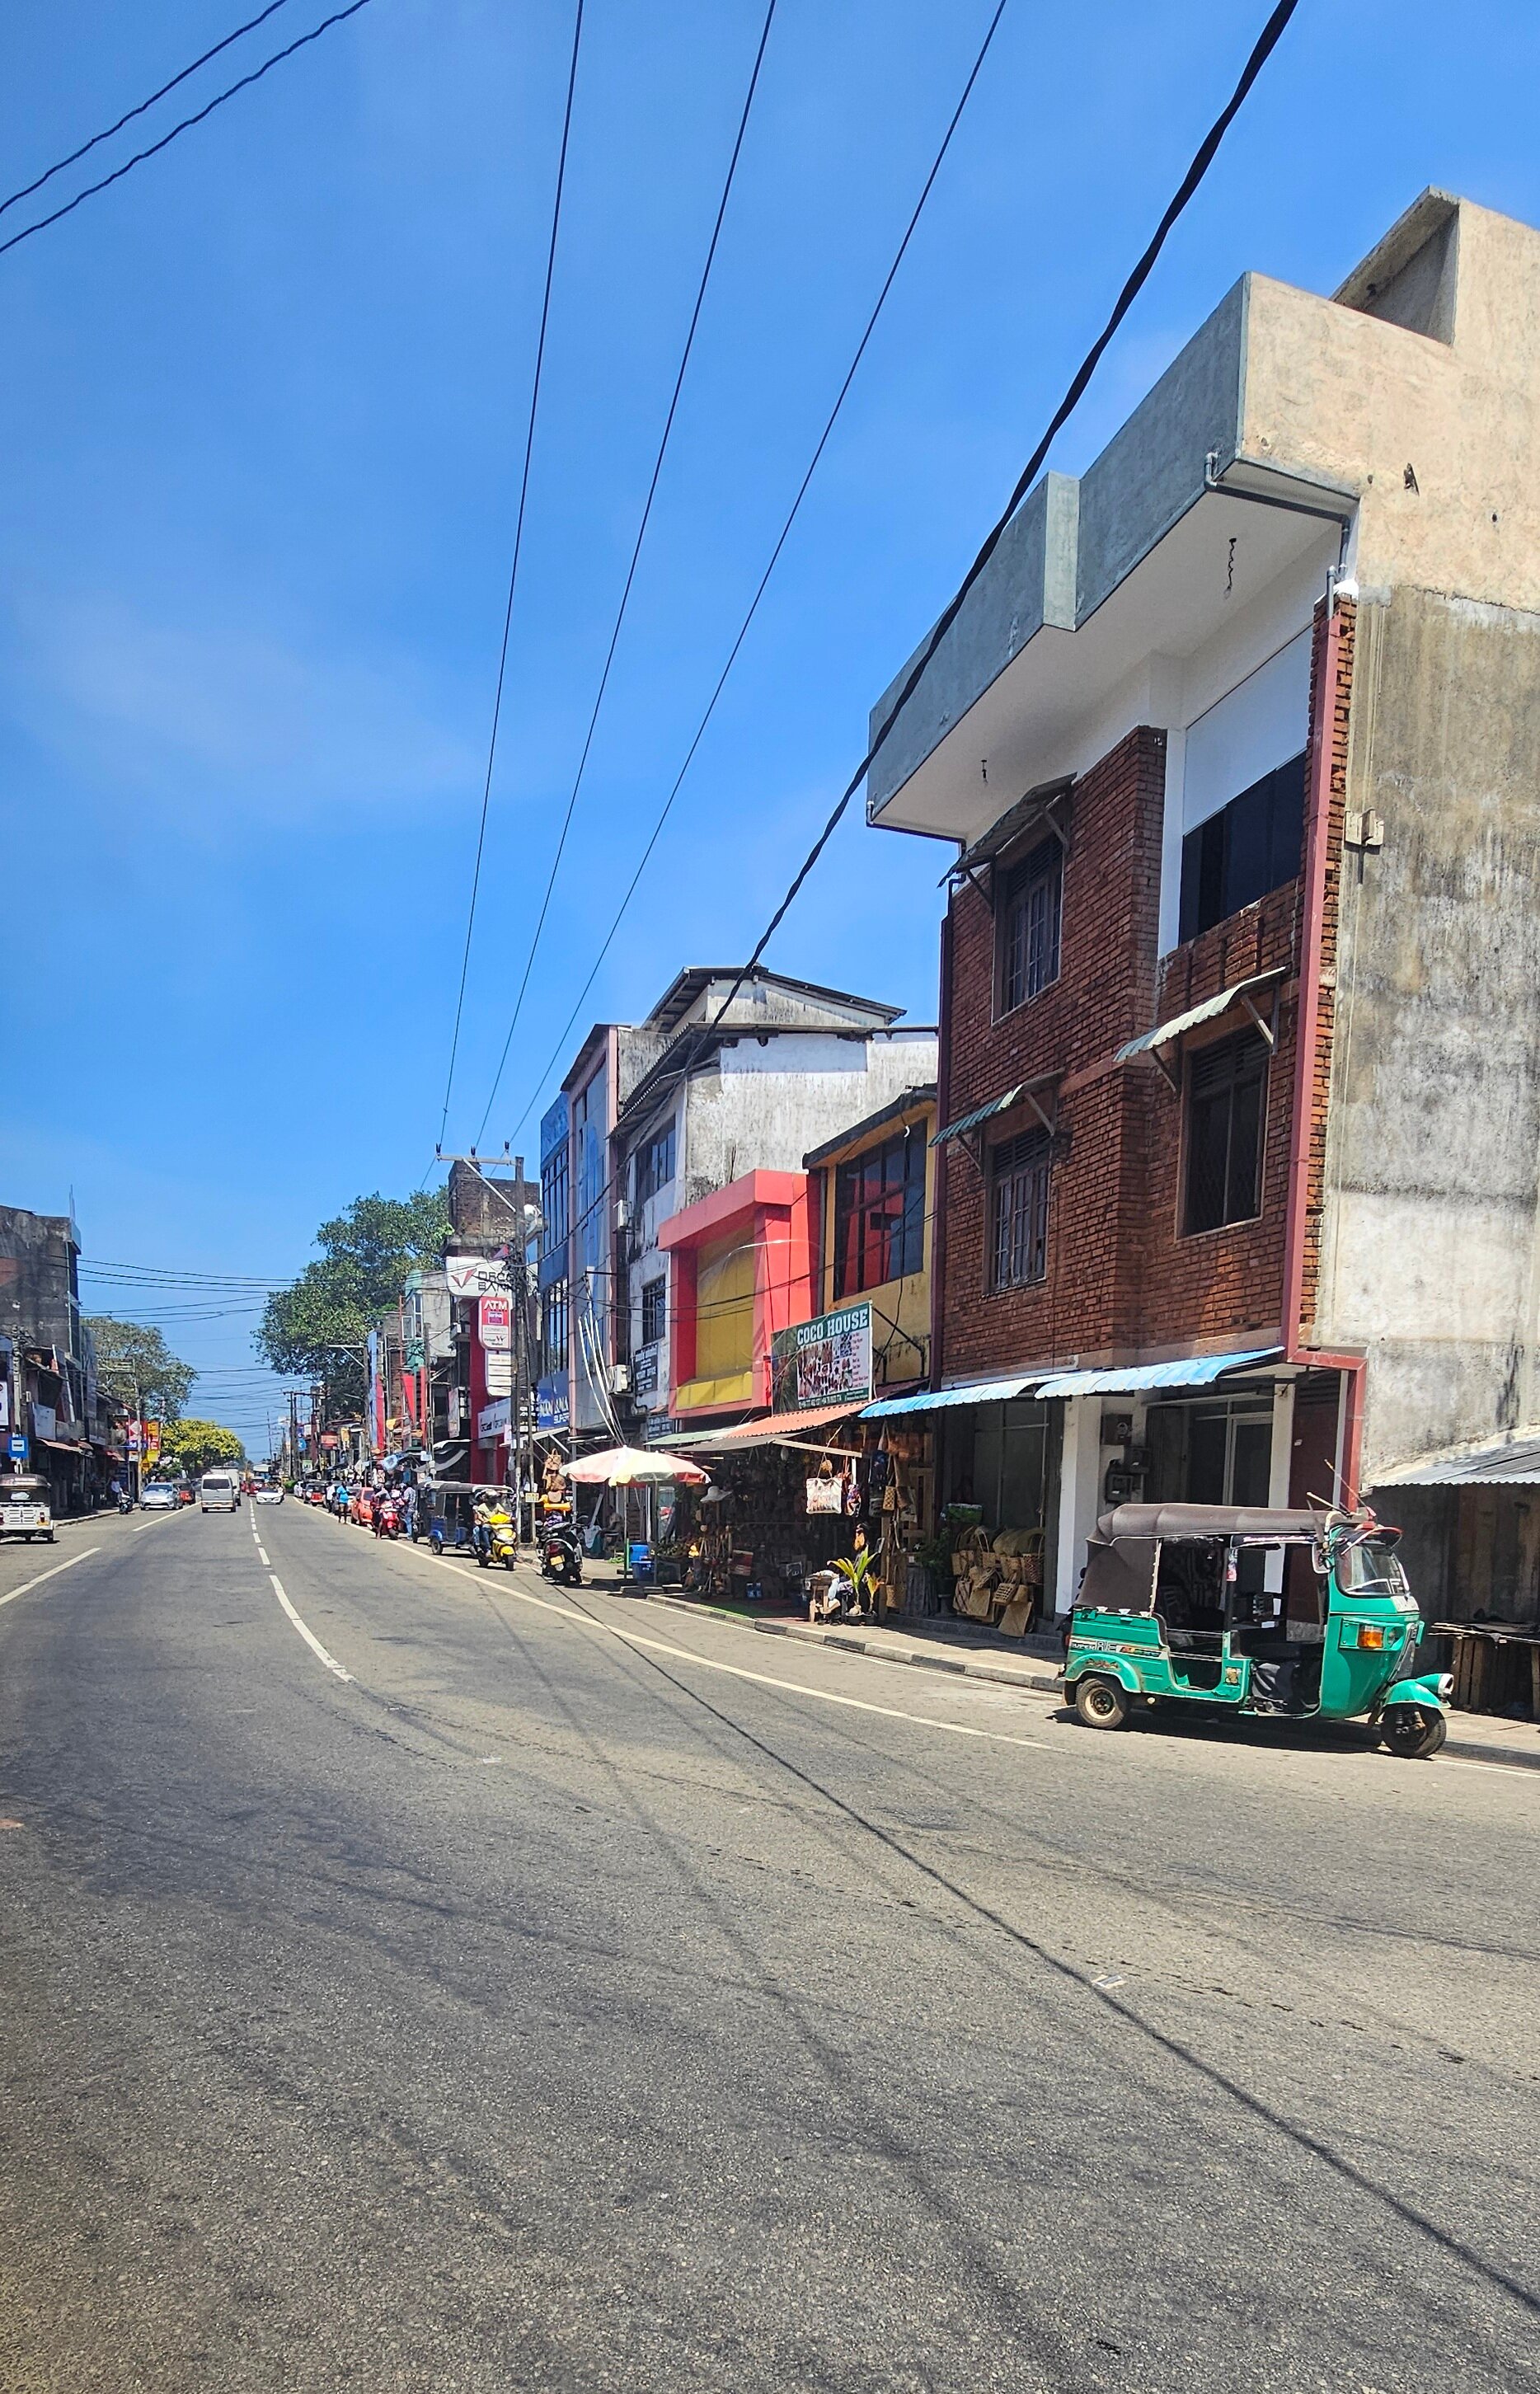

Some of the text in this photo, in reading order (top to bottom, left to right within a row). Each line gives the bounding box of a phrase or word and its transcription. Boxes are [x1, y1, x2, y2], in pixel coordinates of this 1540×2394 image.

[483, 1299, 508, 1310] ATM
[796, 1307, 868, 1346] COCO HOUSE
[1073, 1642, 1096, 1650] SUPER
